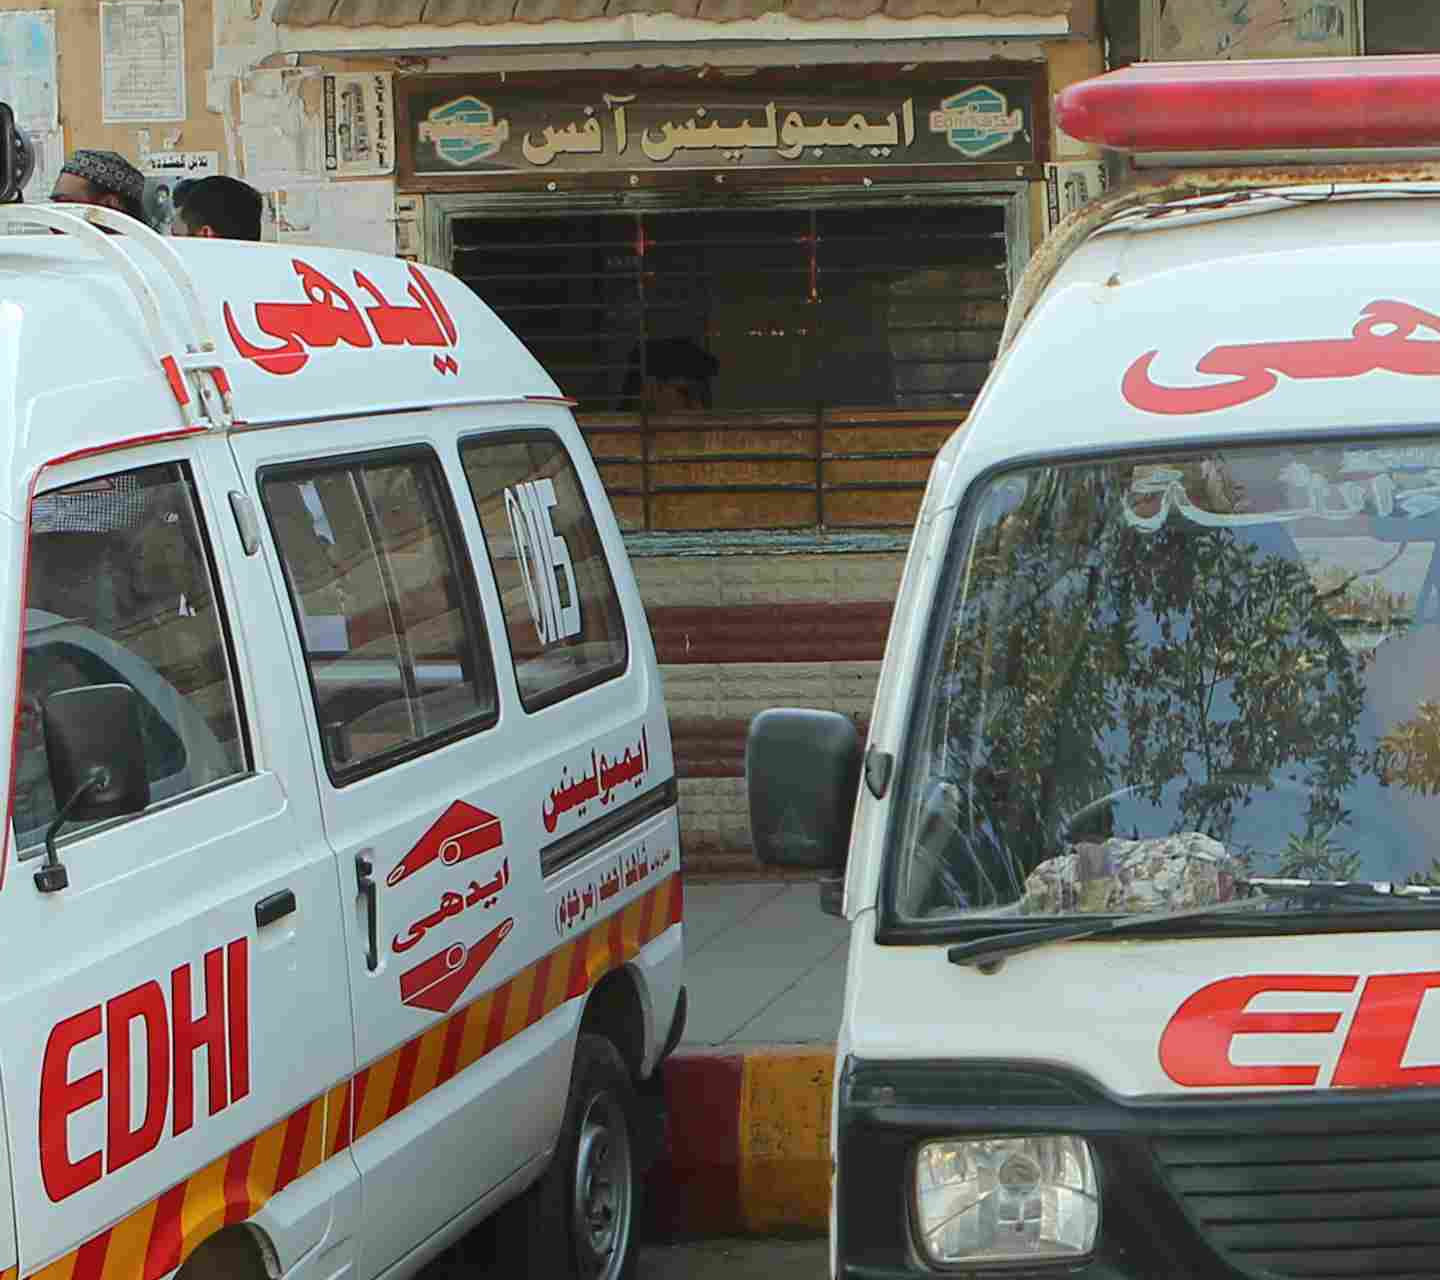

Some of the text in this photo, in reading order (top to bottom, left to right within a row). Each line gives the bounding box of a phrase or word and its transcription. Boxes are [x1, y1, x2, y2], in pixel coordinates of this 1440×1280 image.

[523, 93, 915, 166] ایمبولینس آفس
[542, 723, 649, 833] ایمبولینس
[39, 935, 252, 1204] EDHI
